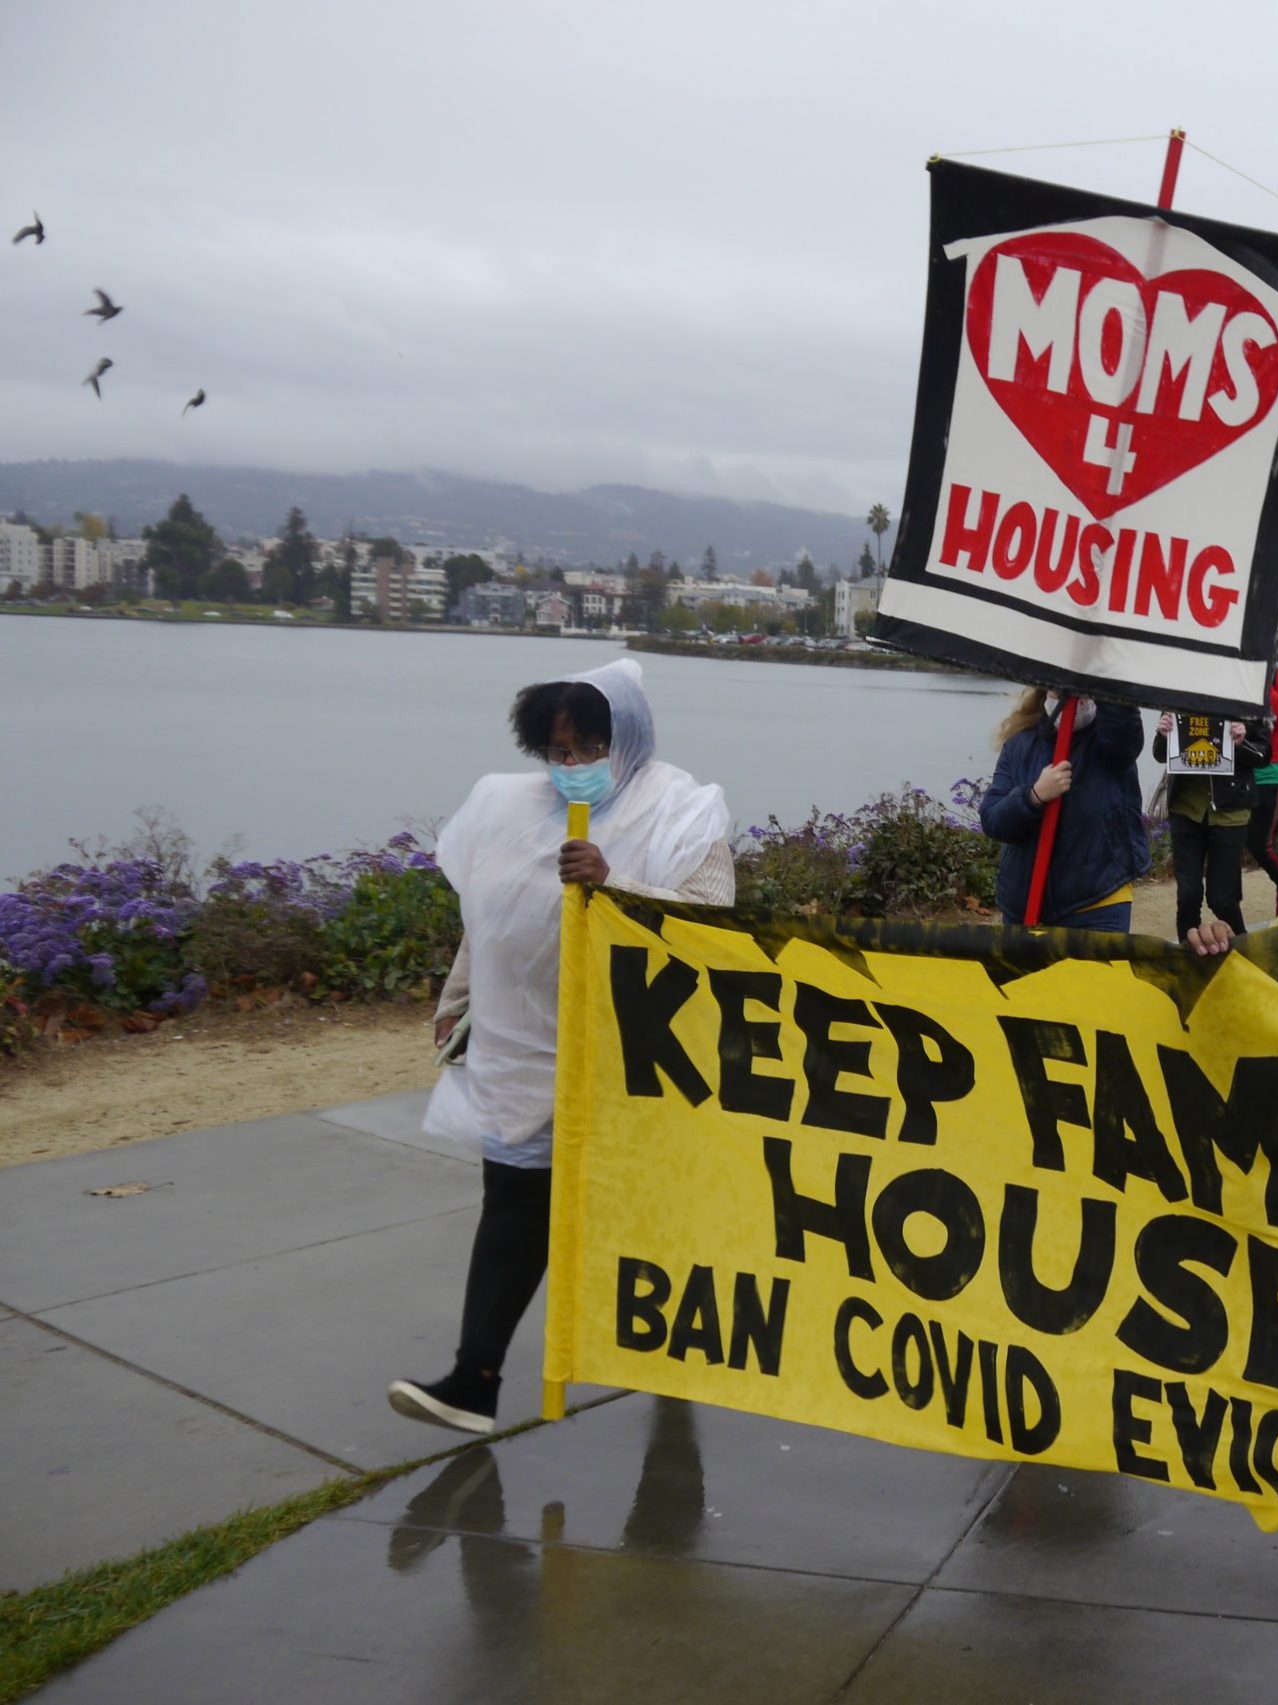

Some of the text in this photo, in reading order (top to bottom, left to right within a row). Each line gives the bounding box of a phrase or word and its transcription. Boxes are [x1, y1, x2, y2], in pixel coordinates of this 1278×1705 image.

[988, 253, 1278, 427] MOMS
[1083, 413, 1137, 496] 4
[939, 483, 1240, 628] HOUSING
[1189, 717, 1209, 727] FREE
[1189, 726, 1210, 737] ZONE
[610, 944, 976, 1146] KEEP
[616, 1256, 791, 1377] BAN
[834, 1296, 1062, 1456] COVID
